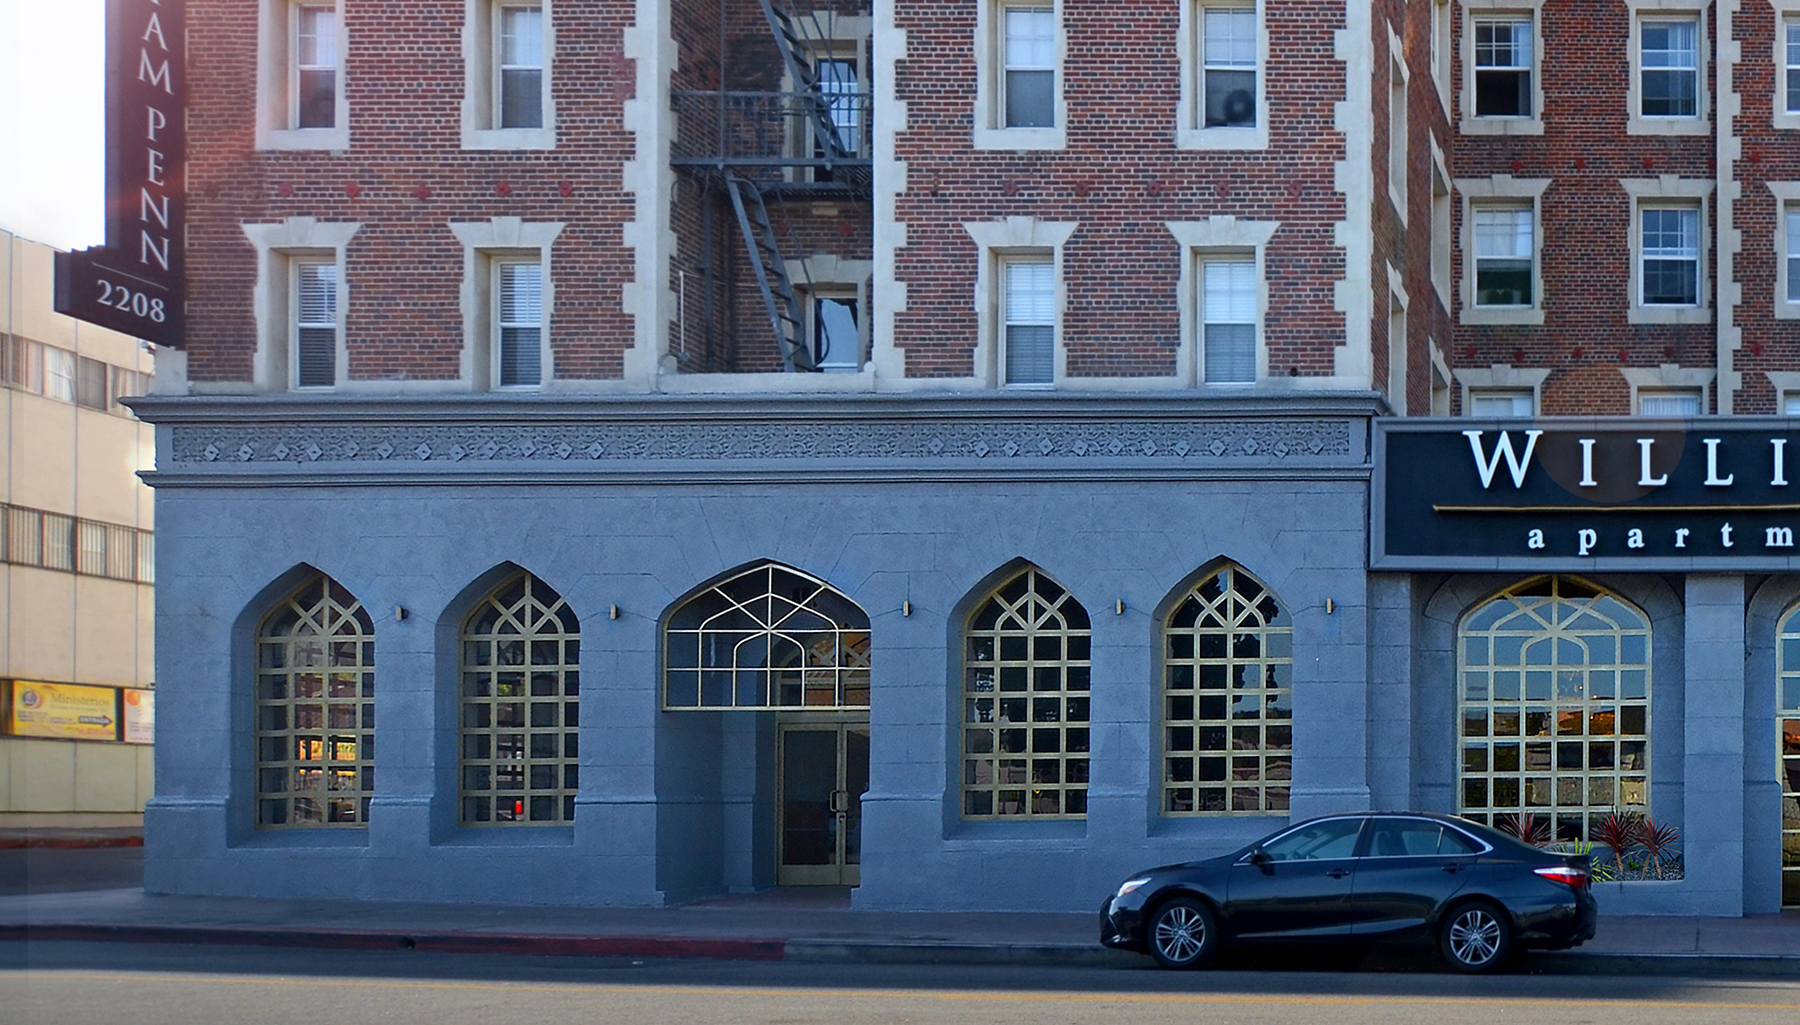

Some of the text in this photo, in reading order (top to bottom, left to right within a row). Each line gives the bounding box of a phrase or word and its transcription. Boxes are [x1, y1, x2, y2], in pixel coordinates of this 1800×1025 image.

[140, 105, 170, 271] PENN
[97, 279, 166, 323] 2208
[51, 693, 109, 706] Ministerios
